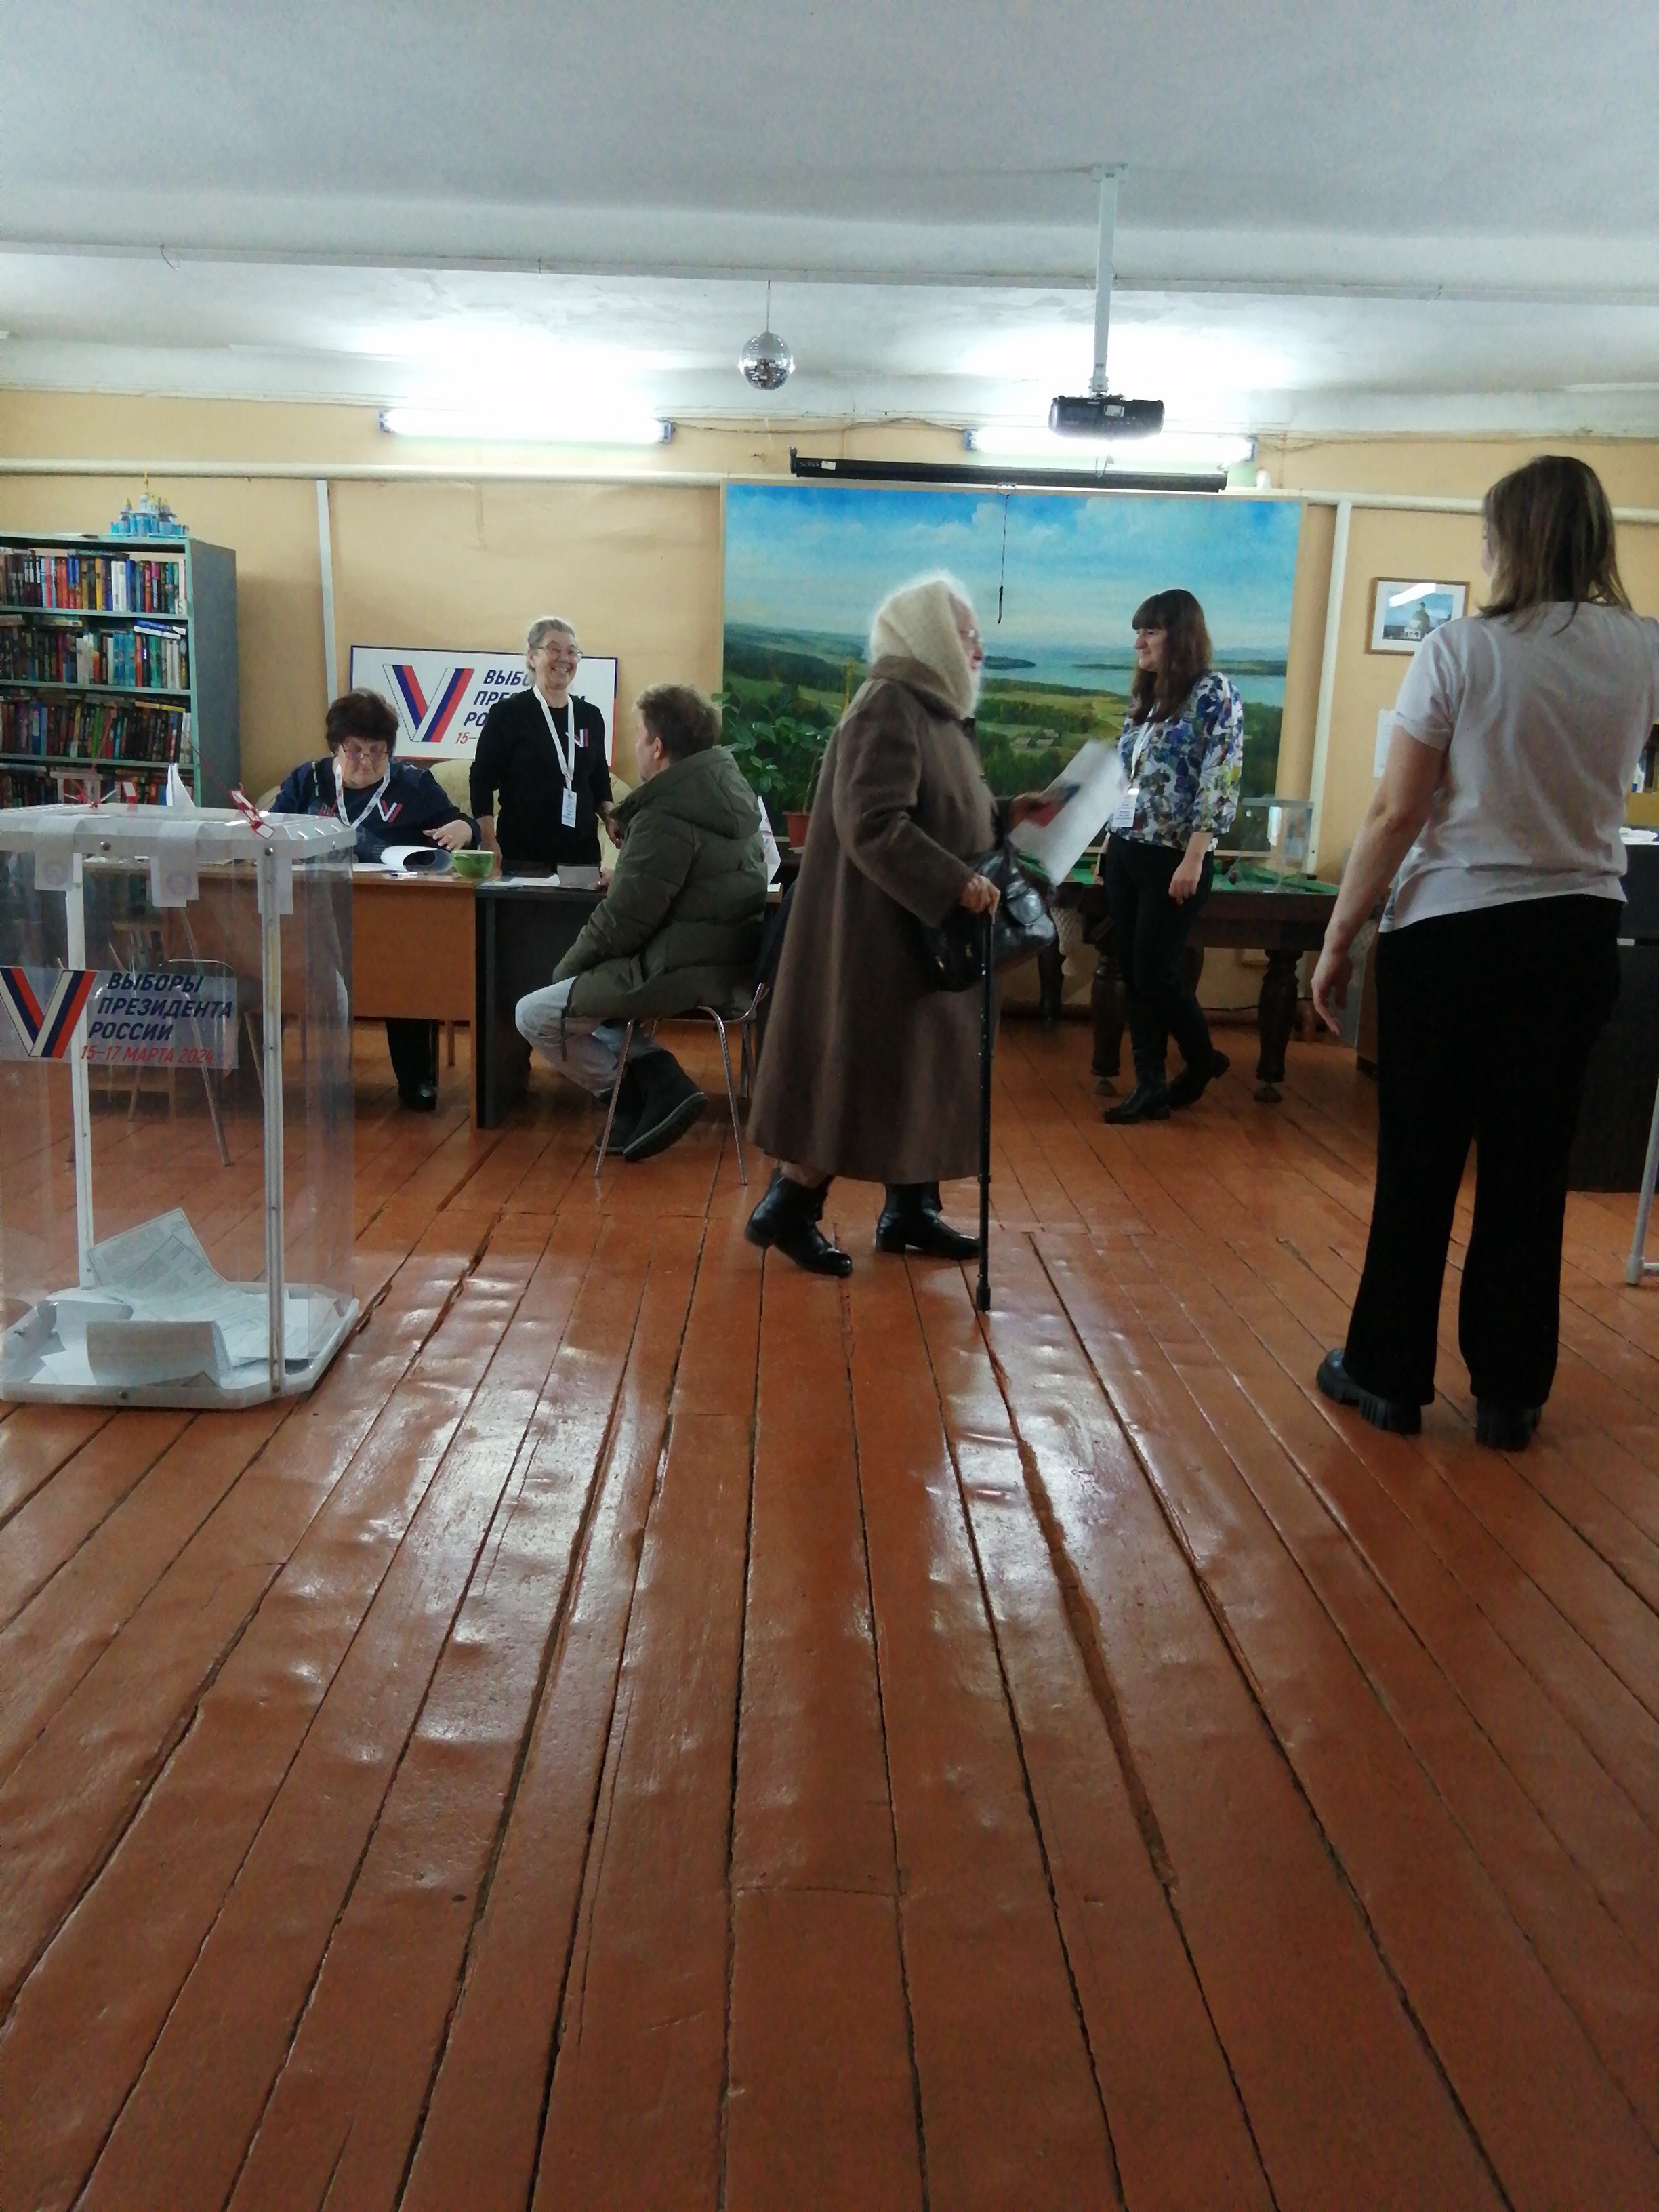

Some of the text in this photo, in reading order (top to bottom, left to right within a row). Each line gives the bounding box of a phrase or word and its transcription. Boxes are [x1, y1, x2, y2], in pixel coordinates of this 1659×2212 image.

[107, 972, 203, 993] ВЫБОРЫ
[98, 997, 232, 1019] ПРЕЗИДЕНТА
[88, 1021, 173, 1041] РОССИИ
[123, 1046, 174, 1063] МАРТА
[178, 1048, 214, 1064] 2024
